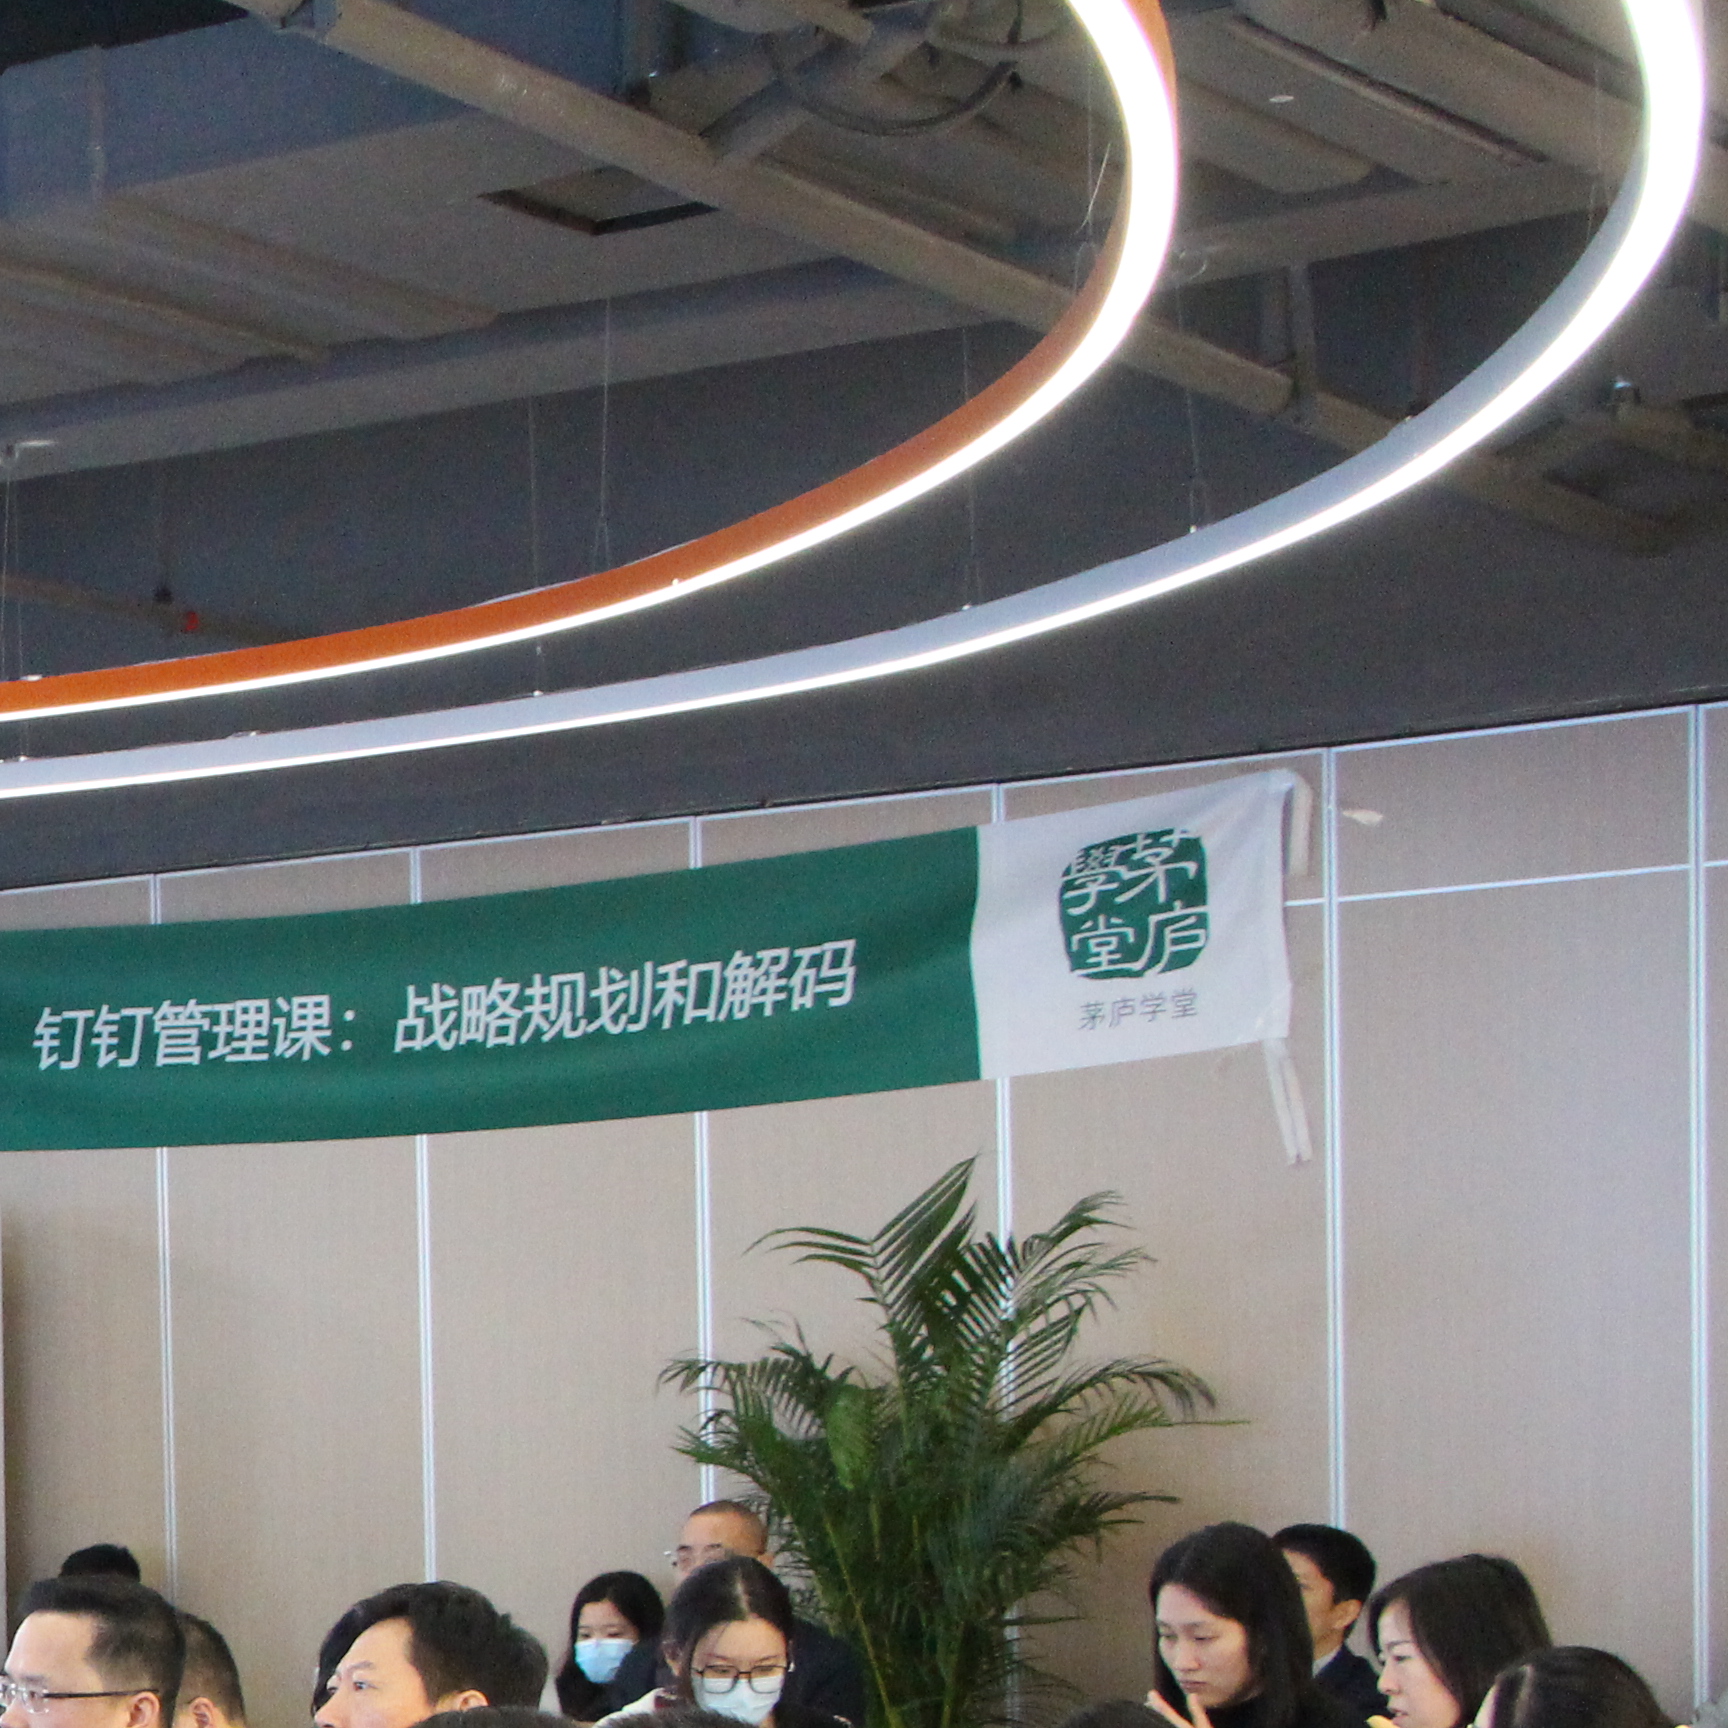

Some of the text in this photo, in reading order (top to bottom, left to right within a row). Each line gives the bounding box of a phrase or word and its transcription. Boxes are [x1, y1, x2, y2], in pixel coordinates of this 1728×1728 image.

[32, 939, 857, 1071] 钉钉管理课：战略规划和解码
[1078, 988, 1198, 1031] 茅庐学堂
